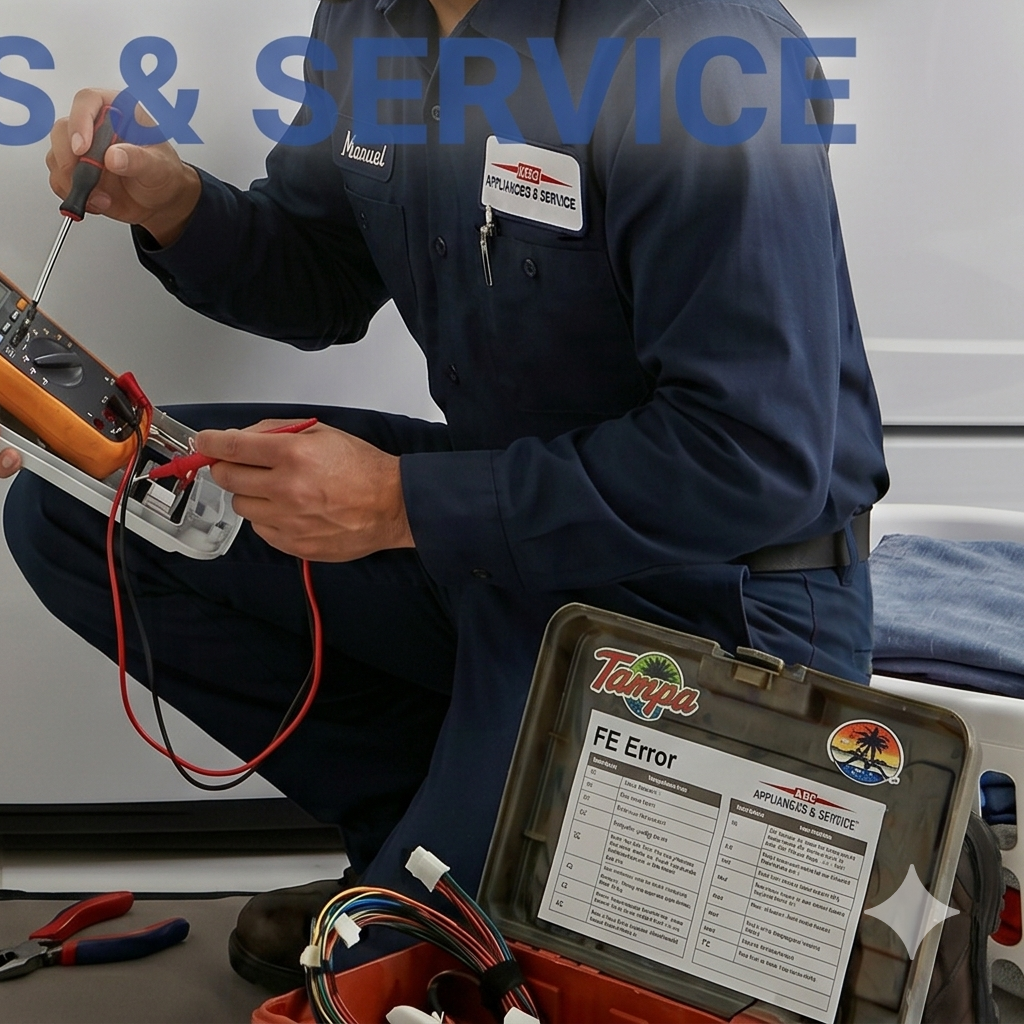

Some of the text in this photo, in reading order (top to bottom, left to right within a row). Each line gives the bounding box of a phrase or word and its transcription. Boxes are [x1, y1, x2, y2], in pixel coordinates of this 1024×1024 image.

[591, 649, 699, 716] Tampa
[593, 725, 621, 752] FE
[624, 736, 678, 769] Error
[794, 788, 817, 804] ABC
